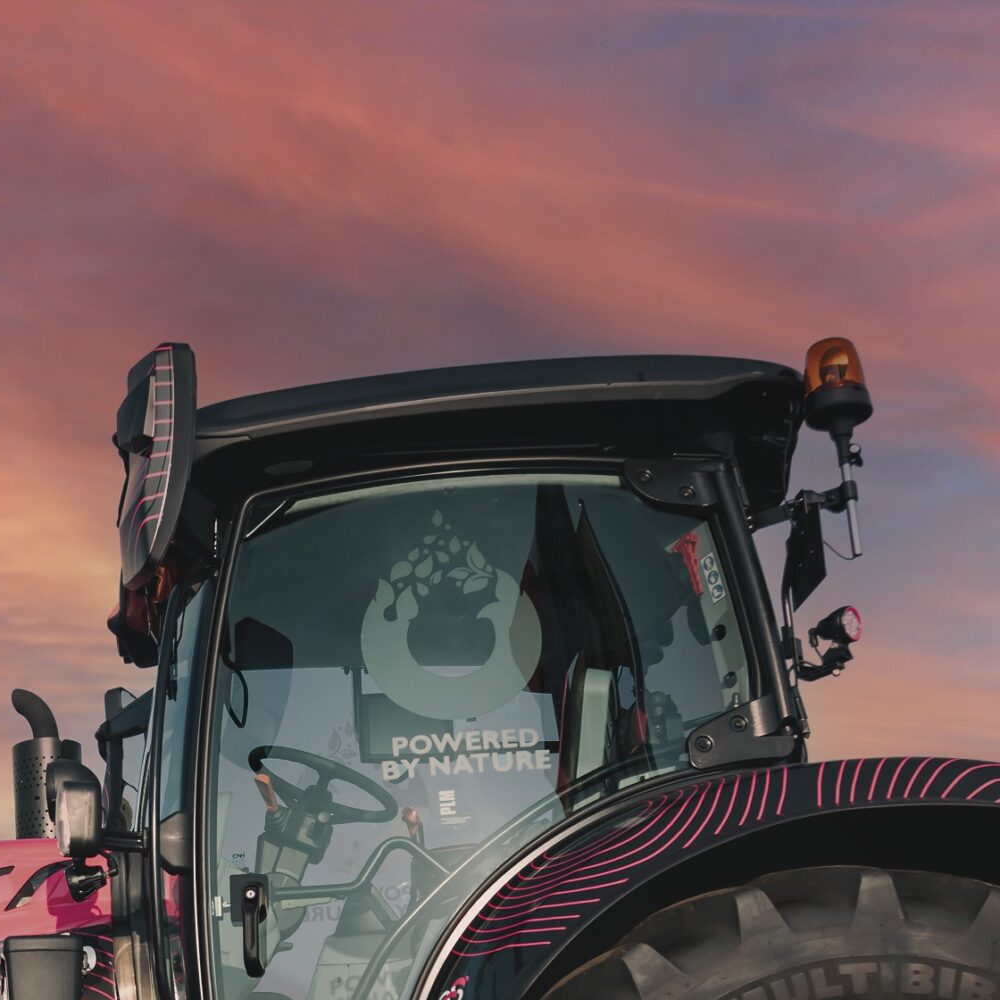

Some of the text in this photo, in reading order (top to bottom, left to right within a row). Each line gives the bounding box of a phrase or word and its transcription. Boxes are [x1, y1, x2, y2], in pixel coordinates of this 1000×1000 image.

[391, 728, 540, 757] POWERED
[381, 749, 552, 781] BY NATURE
